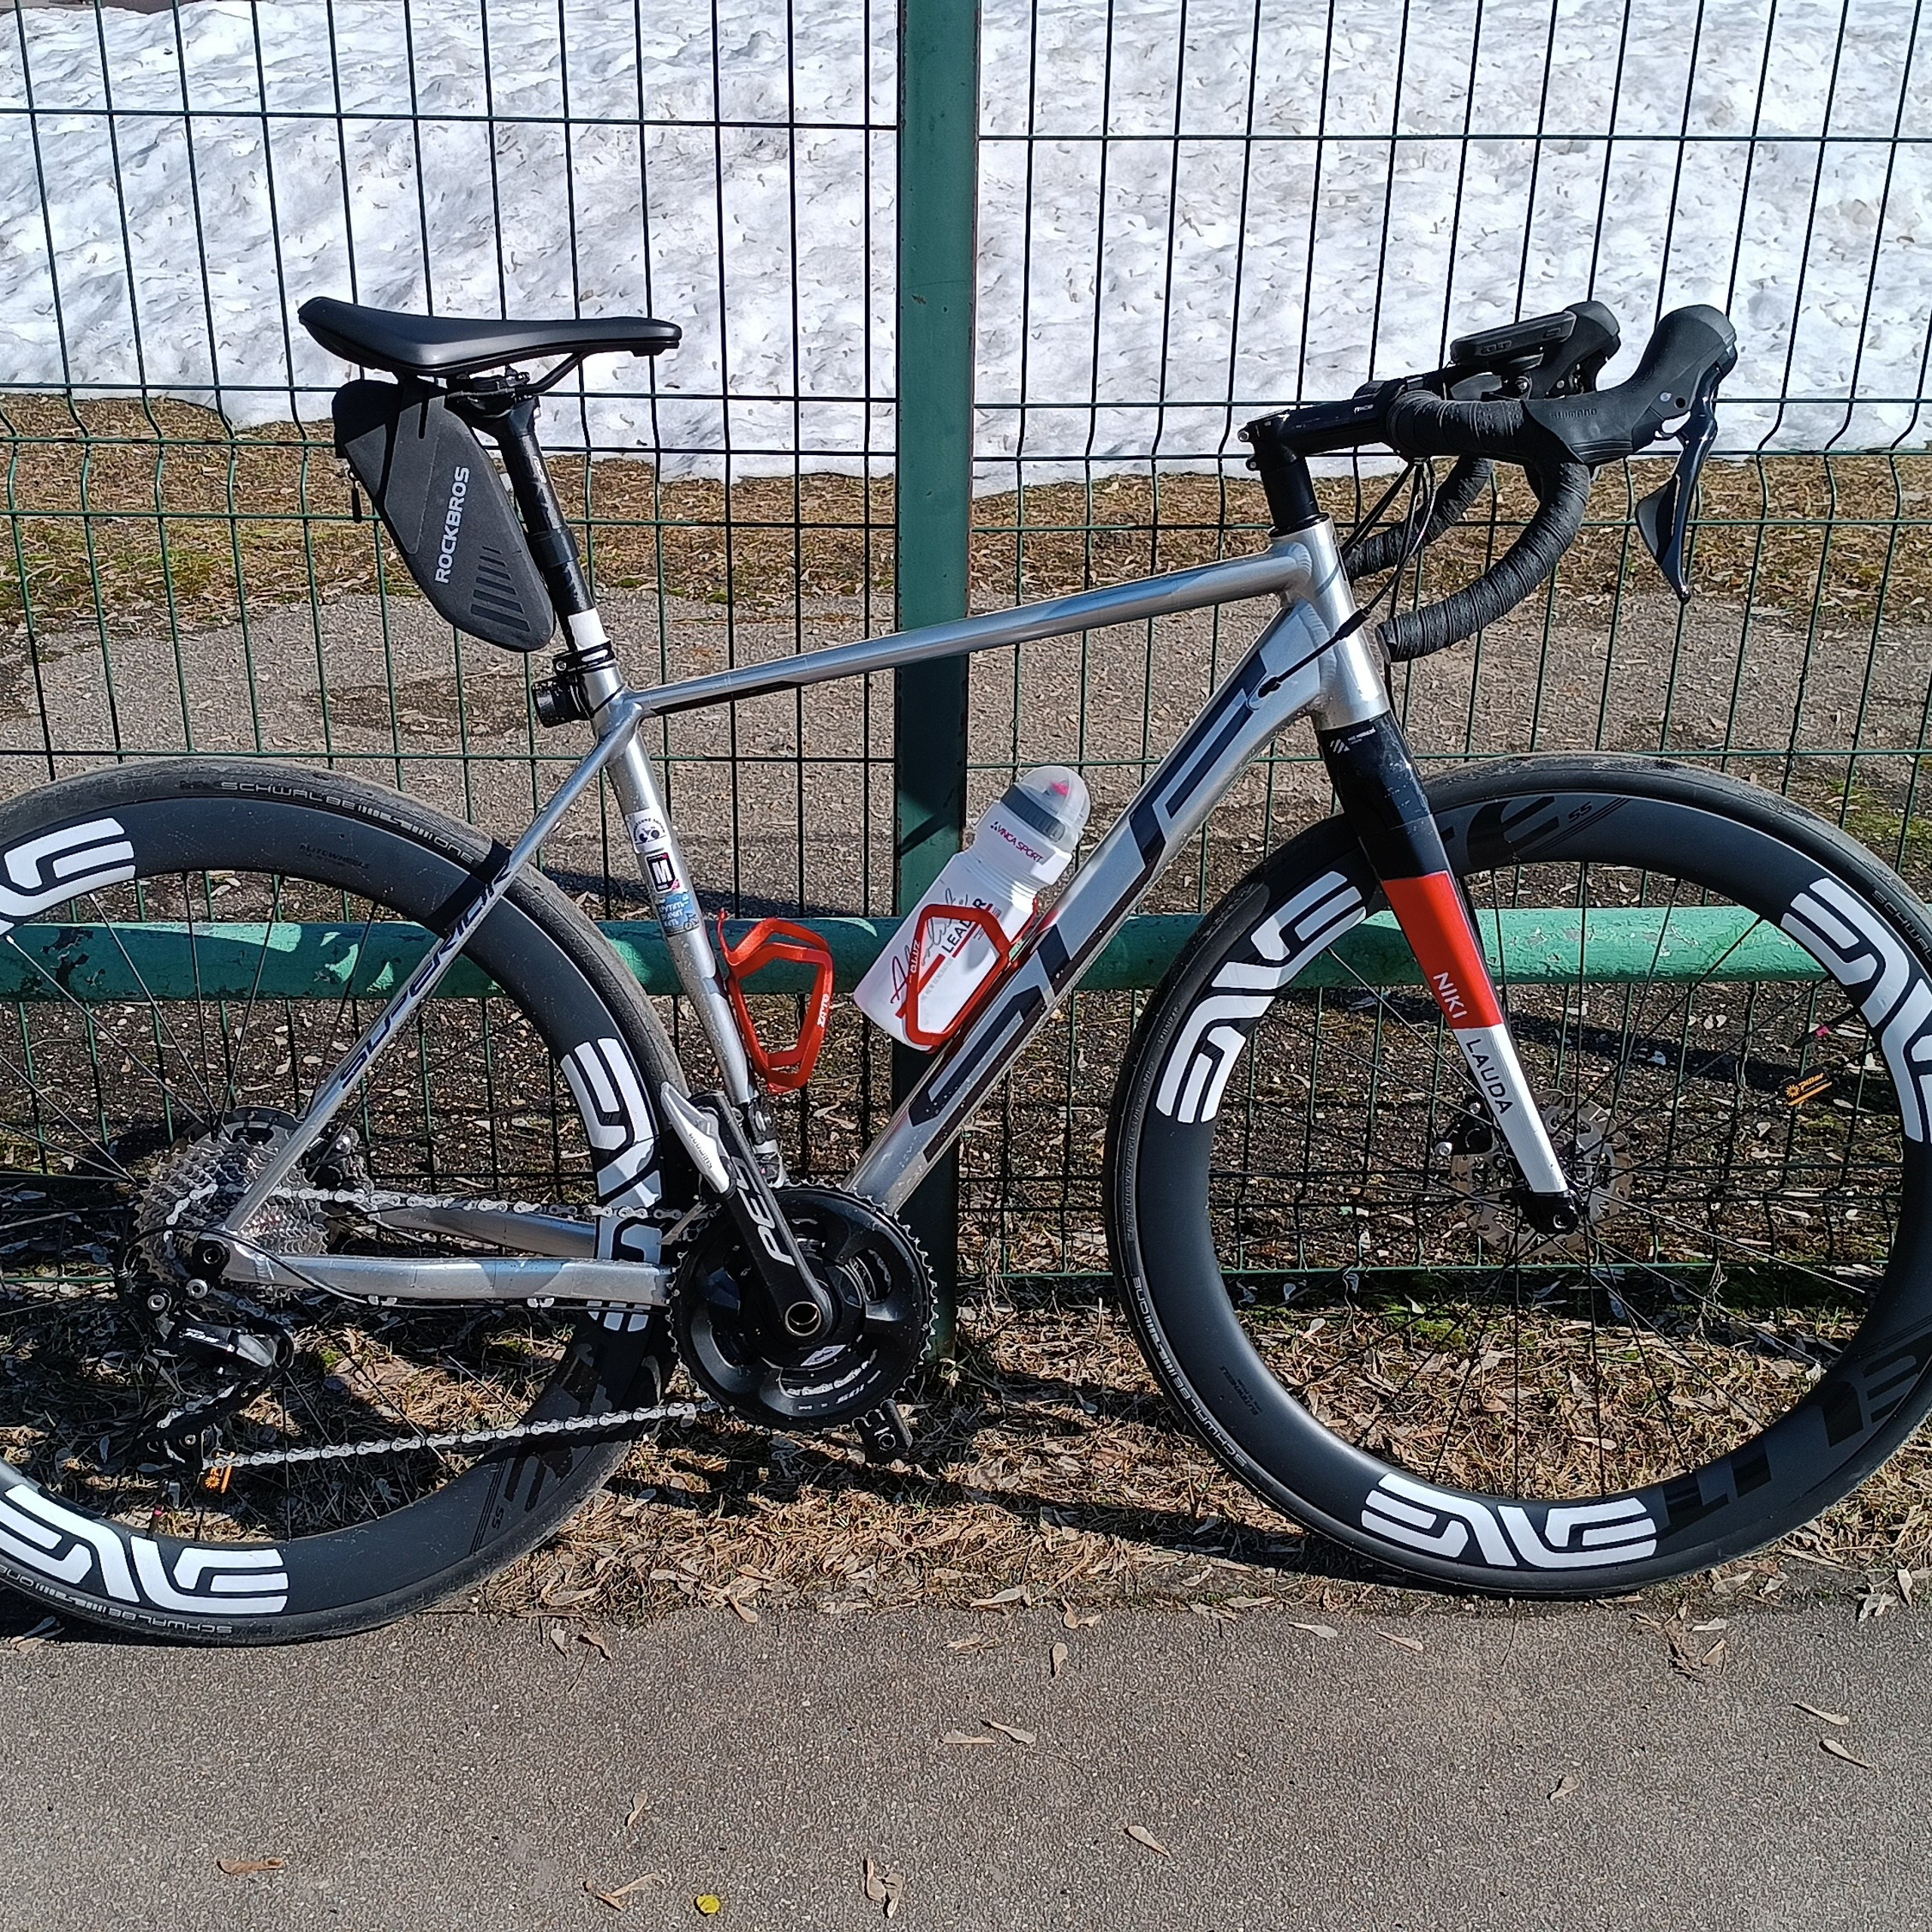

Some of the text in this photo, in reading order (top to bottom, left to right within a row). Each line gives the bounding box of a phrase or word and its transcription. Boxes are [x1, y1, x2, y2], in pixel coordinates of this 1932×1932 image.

[435, 466, 469, 583] ROCKBROS
[221, 781, 474, 865] SCHWALBE ONE
[1015, 839, 1043, 863] SPORT
[941, 896, 986, 953] LEADR
[340, 865, 512, 1088] SUPERIOR
[1155, 871, 1366, 1124] ENVE
[1432, 971, 1466, 1020] NIKI
[1466, 1038, 1513, 1115] LAUDA
[1133, 1275, 1150, 1315] ONE
[1168, 1372, 1247, 1468] SCHWALBE
[1361, 1472, 1657, 1569] ENVE
[109, 1607, 233, 1635] SCHWALBE
